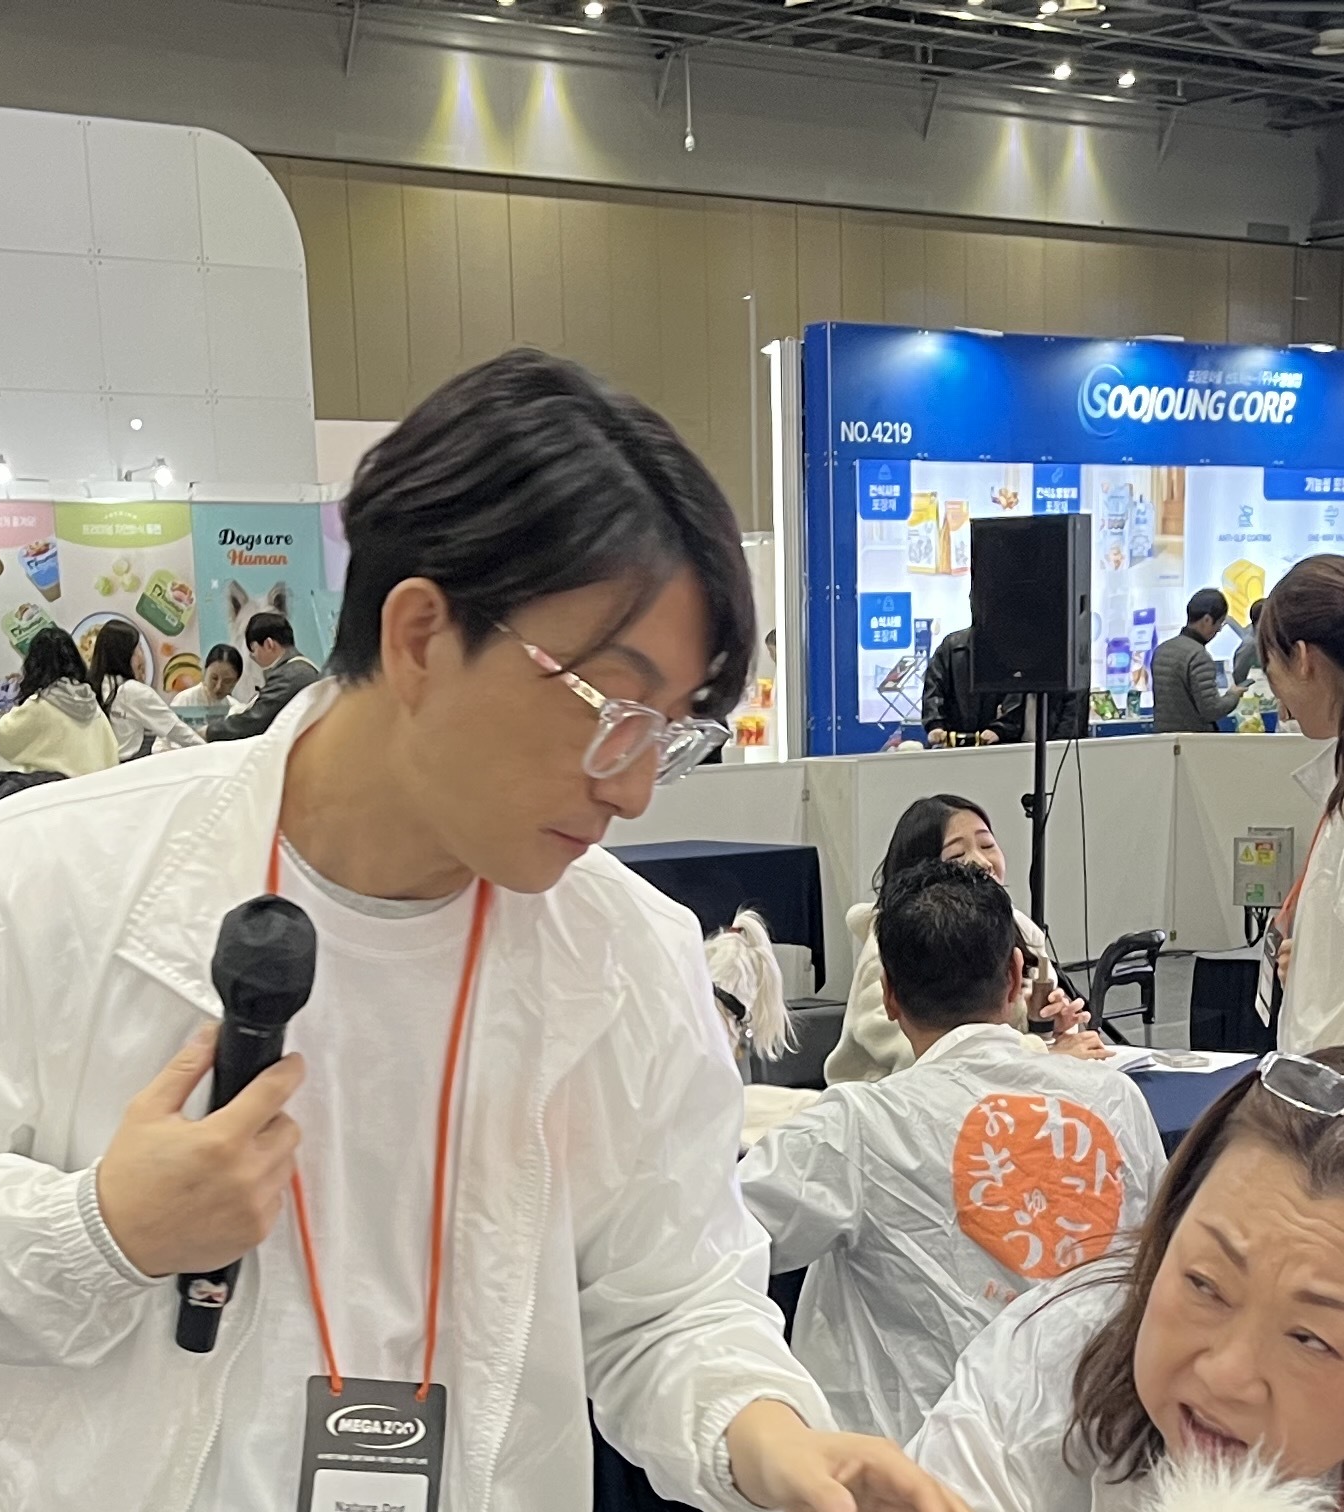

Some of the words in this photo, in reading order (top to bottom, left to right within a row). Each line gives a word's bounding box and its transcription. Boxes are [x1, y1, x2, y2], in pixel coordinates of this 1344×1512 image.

[1083, 382, 1227, 424] SOOJOUNG
[1227, 390, 1297, 425] CORP.
[840, 420, 913, 444] NO.4219
[218, 528, 263, 551] Dogs
[264, 534, 293, 545] are
[227, 549, 288, 566] Human
